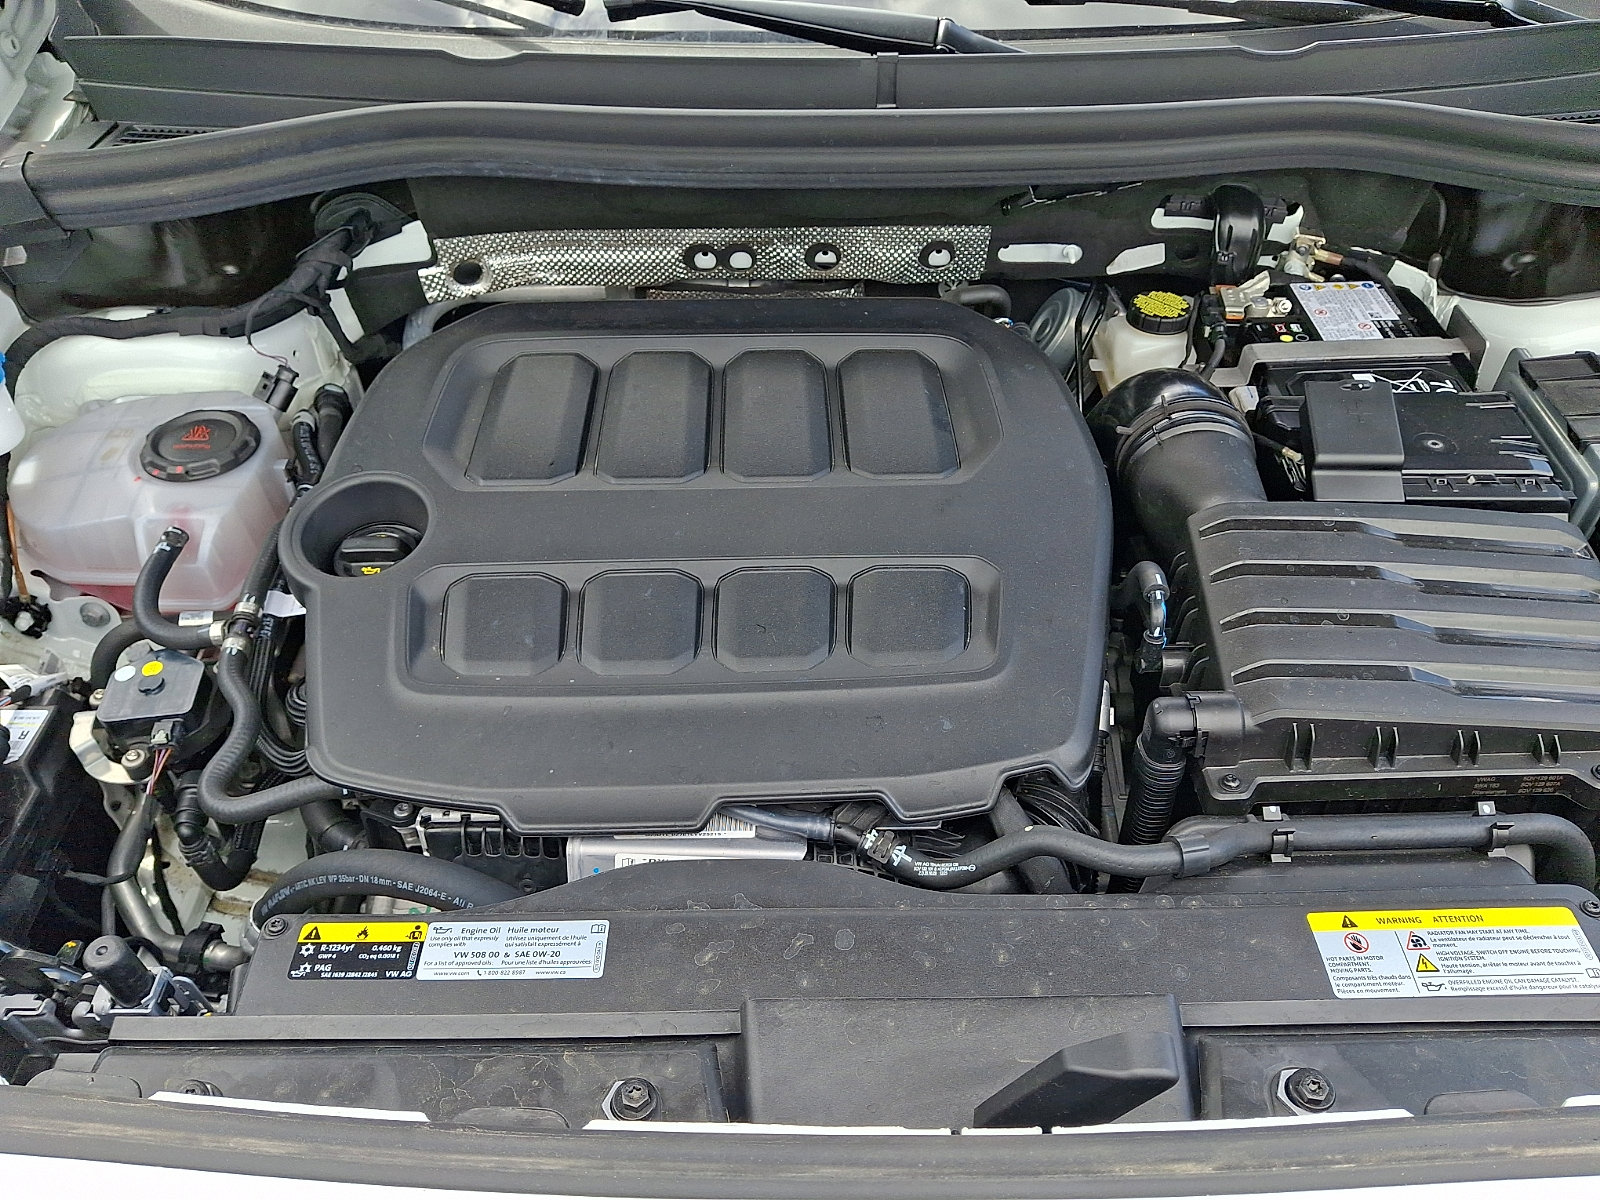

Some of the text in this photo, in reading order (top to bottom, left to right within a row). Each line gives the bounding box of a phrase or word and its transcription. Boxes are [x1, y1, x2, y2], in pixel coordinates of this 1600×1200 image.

[397, 880, 413, 891] SAE
[415, 885, 447, 900] J2064-E
[1433, 915, 1484, 923] ATTENTION
[461, 927, 488, 936] Engine
[320, 944, 355, 953] R-1234yf
